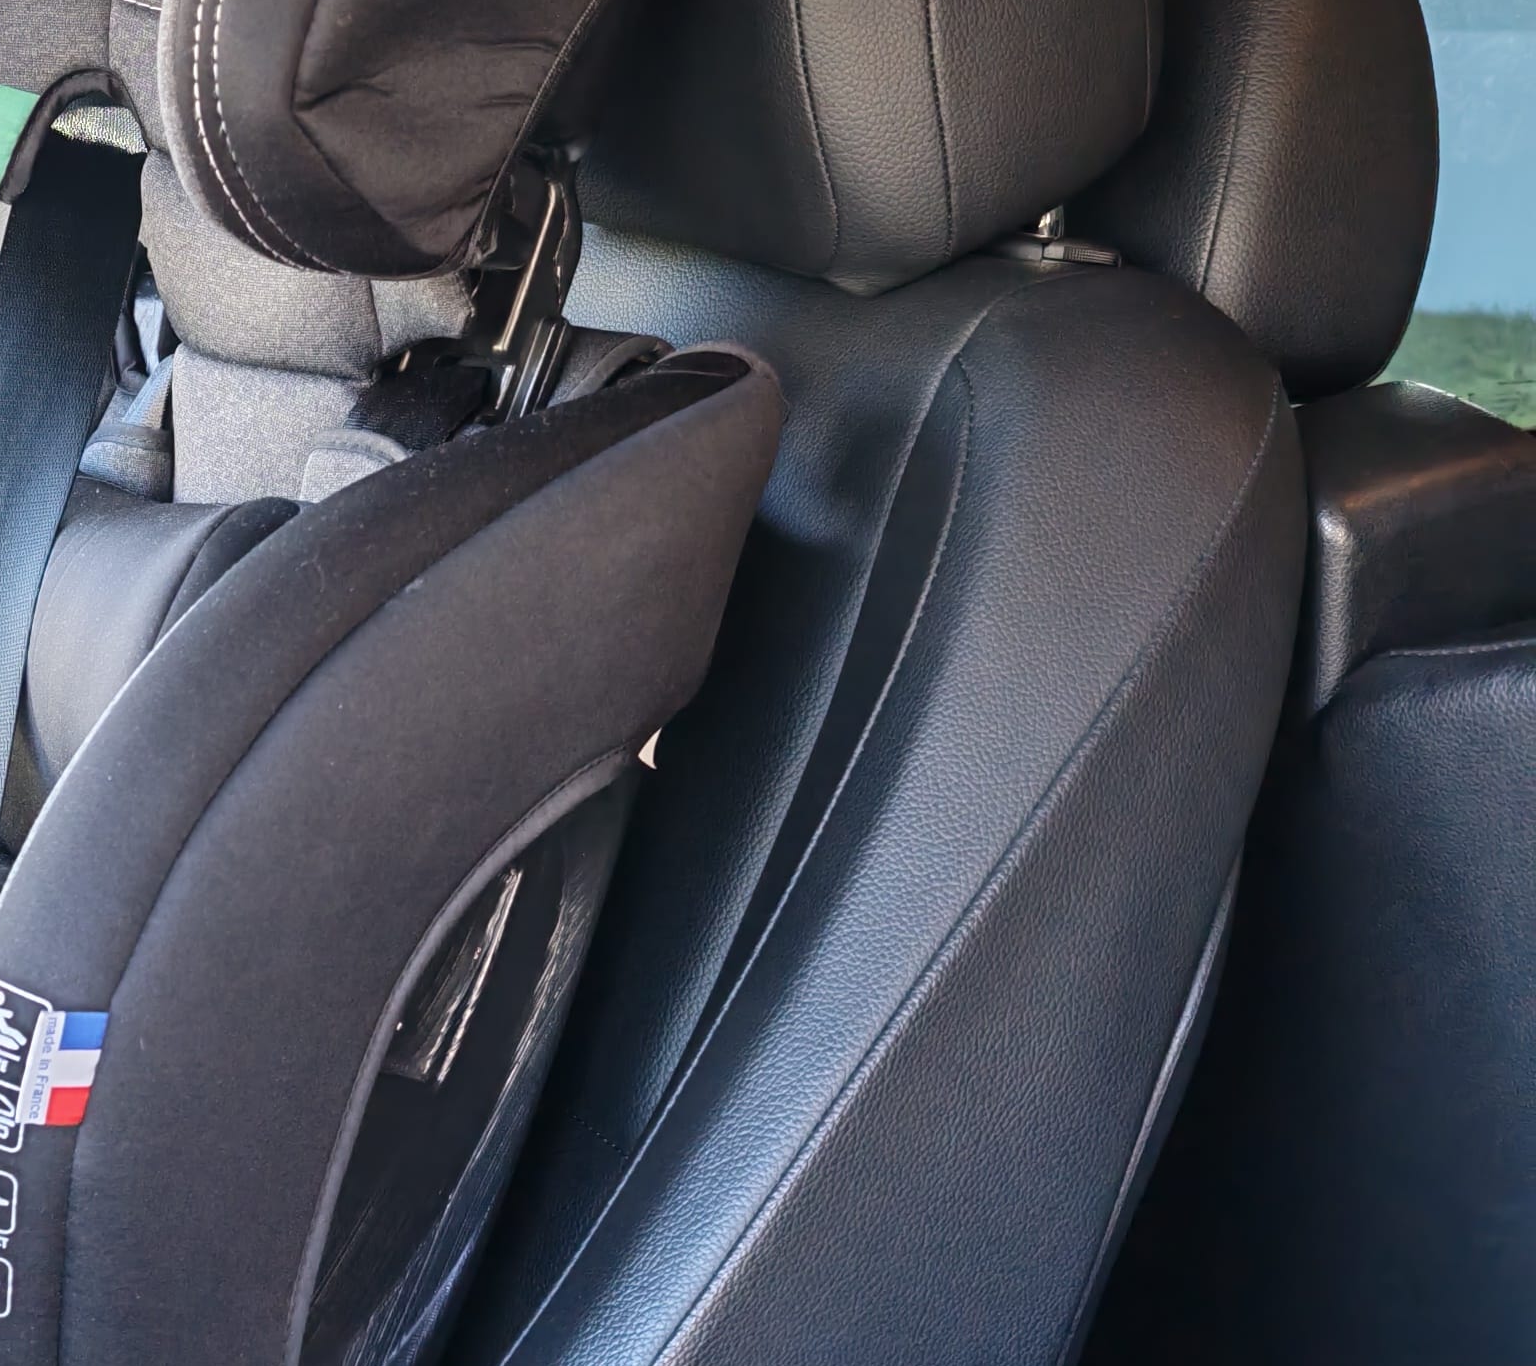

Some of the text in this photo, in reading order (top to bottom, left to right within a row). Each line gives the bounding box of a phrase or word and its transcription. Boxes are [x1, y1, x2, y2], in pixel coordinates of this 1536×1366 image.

[29, 1016, 57, 1119] made in France
